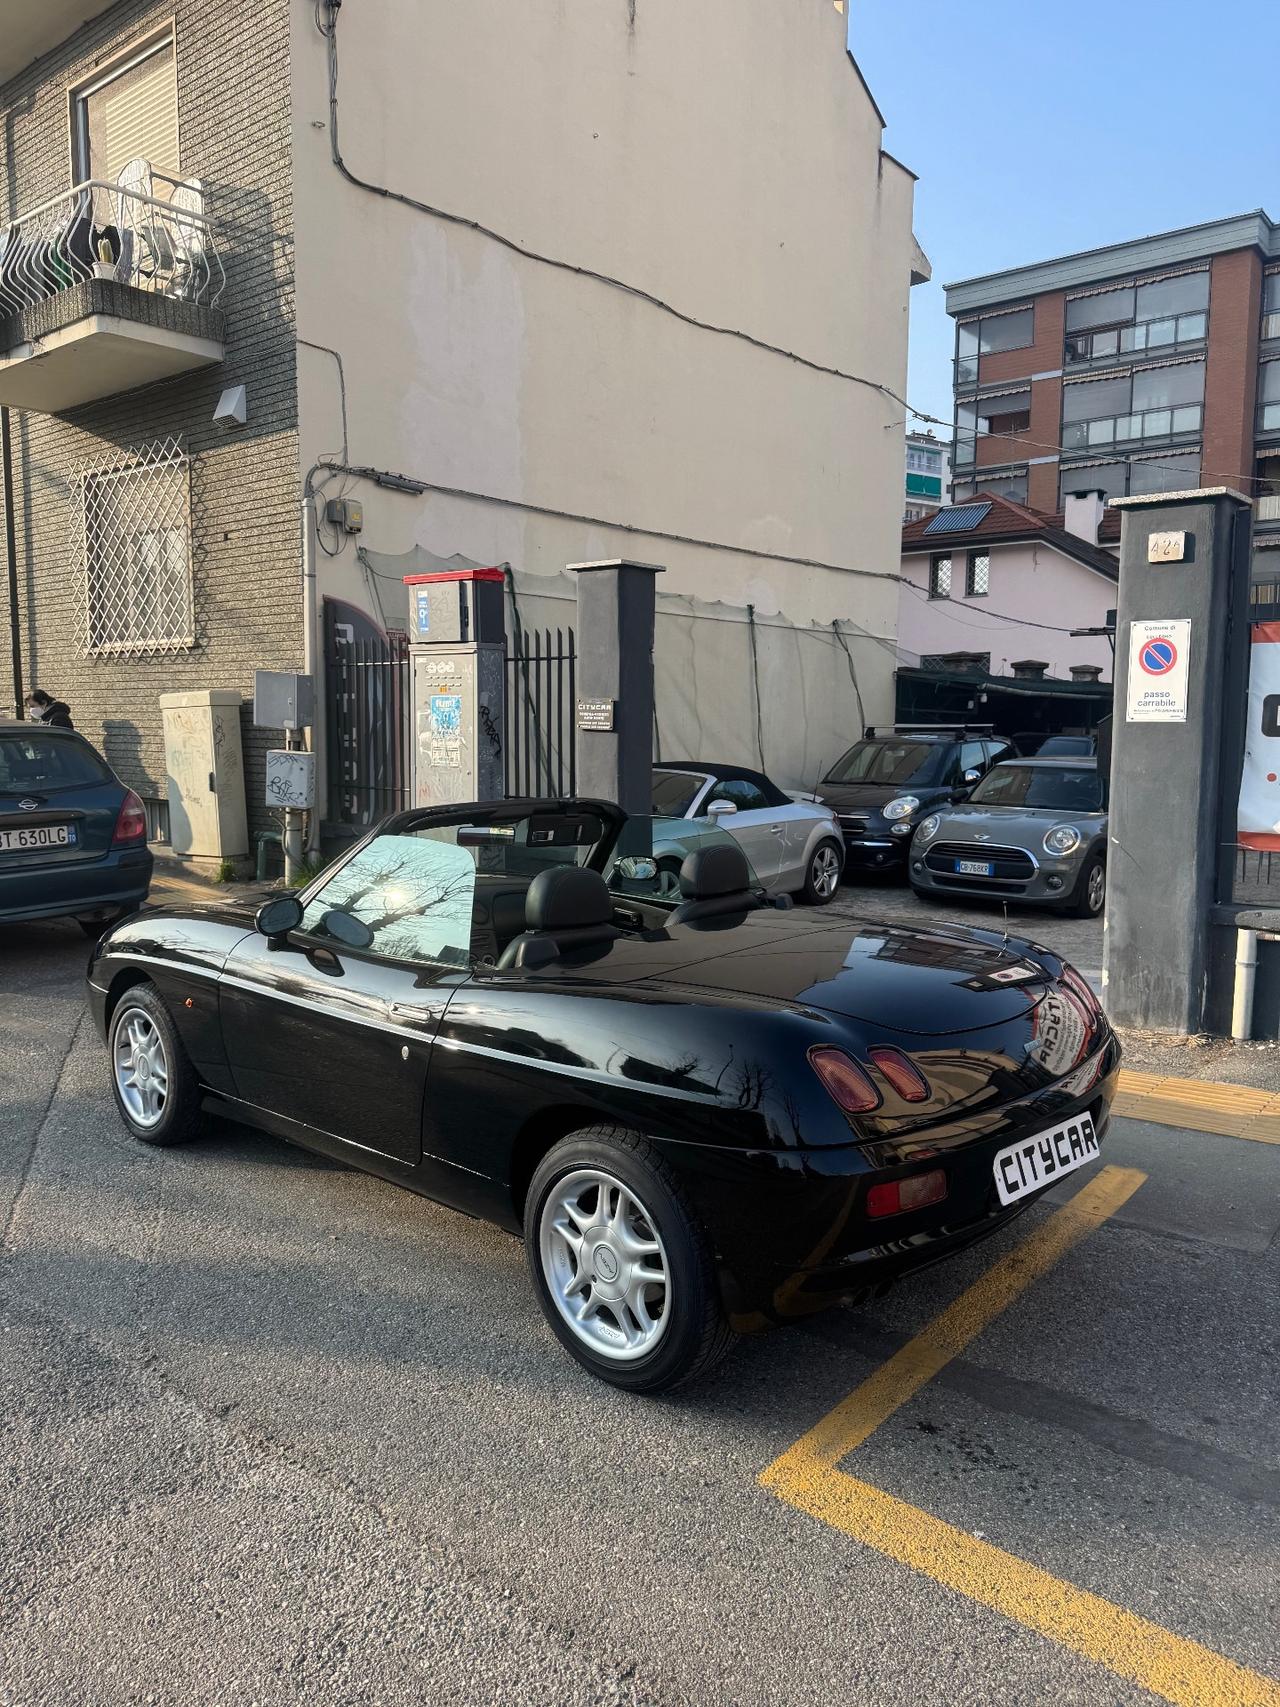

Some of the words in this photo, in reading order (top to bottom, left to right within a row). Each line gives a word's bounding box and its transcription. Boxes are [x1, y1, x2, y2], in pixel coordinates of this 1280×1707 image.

[1144, 691, 1171, 699] passo
[1137, 699, 1176, 707] carrabile
[1000, 1119, 1097, 1194] CITYCAR
